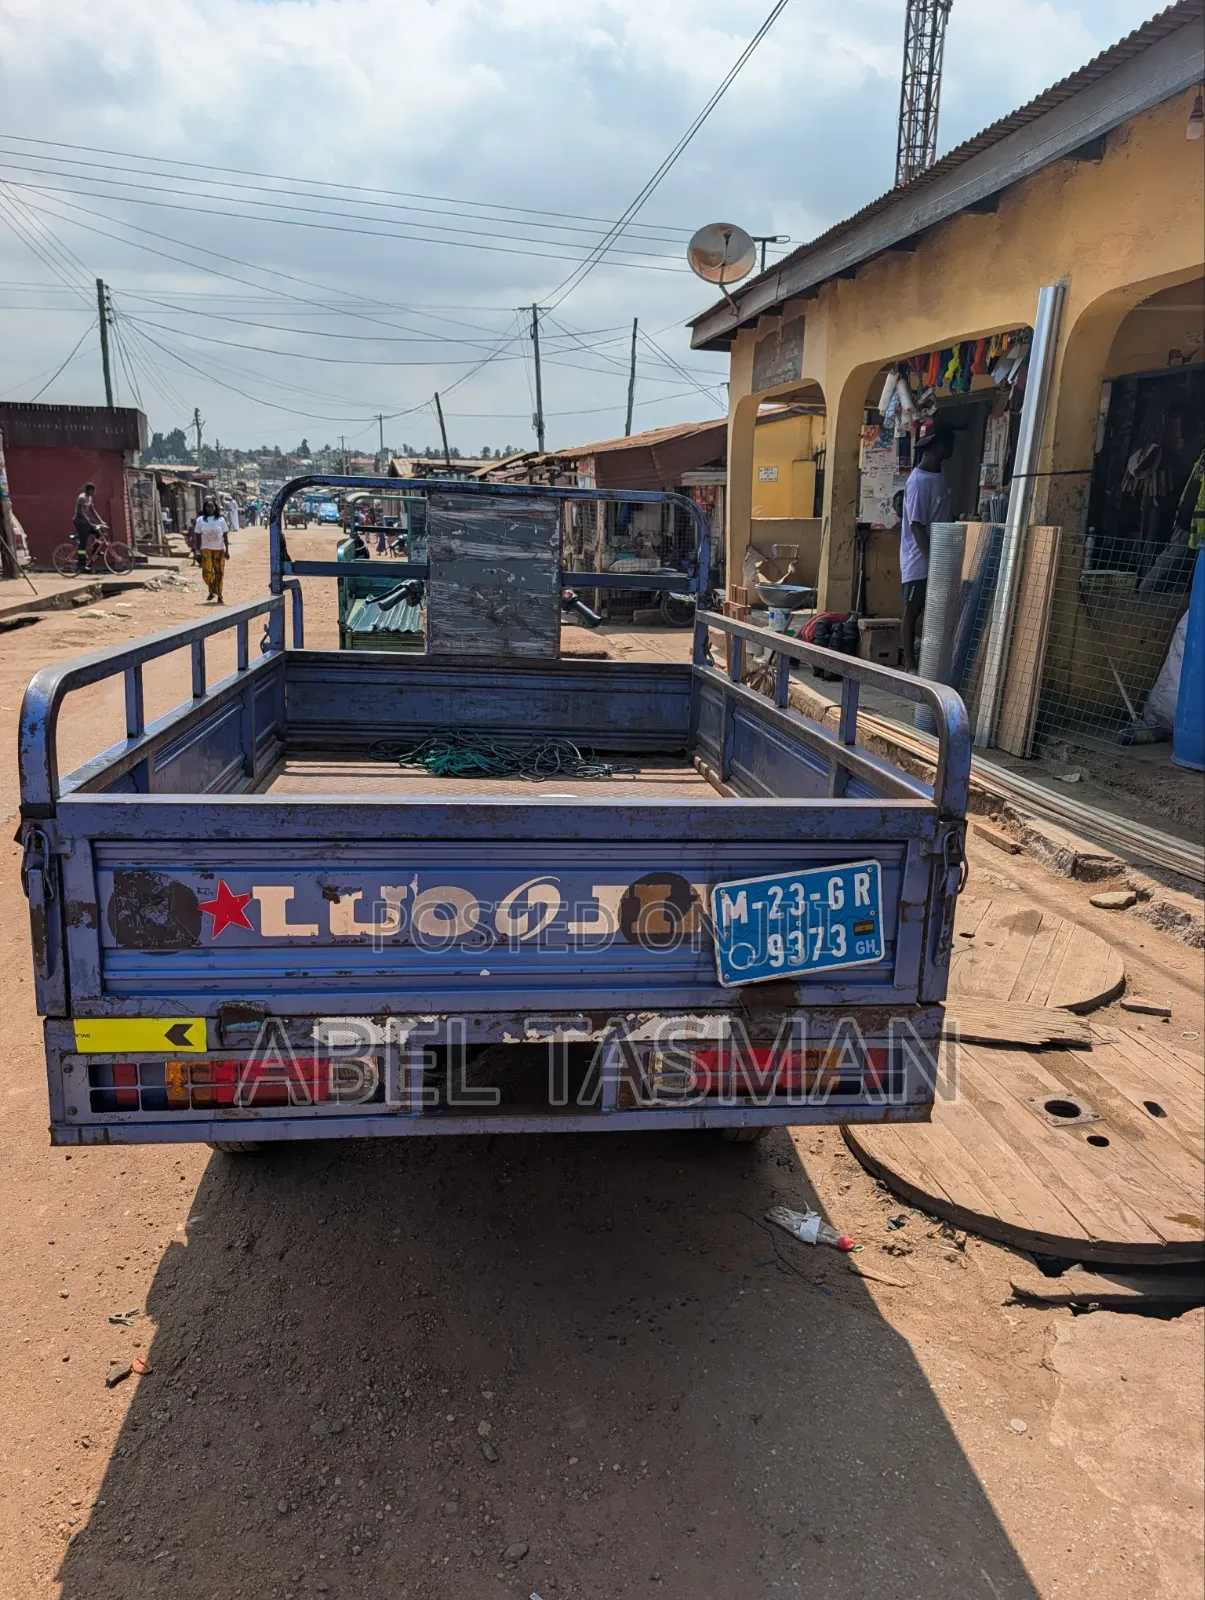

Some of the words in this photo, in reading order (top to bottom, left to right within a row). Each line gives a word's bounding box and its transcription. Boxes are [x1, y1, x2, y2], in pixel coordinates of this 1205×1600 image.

[720, 872, 871, 927] M-23-GR
[768, 923, 847, 967] 9373
[855, 939, 876, 955] GH
